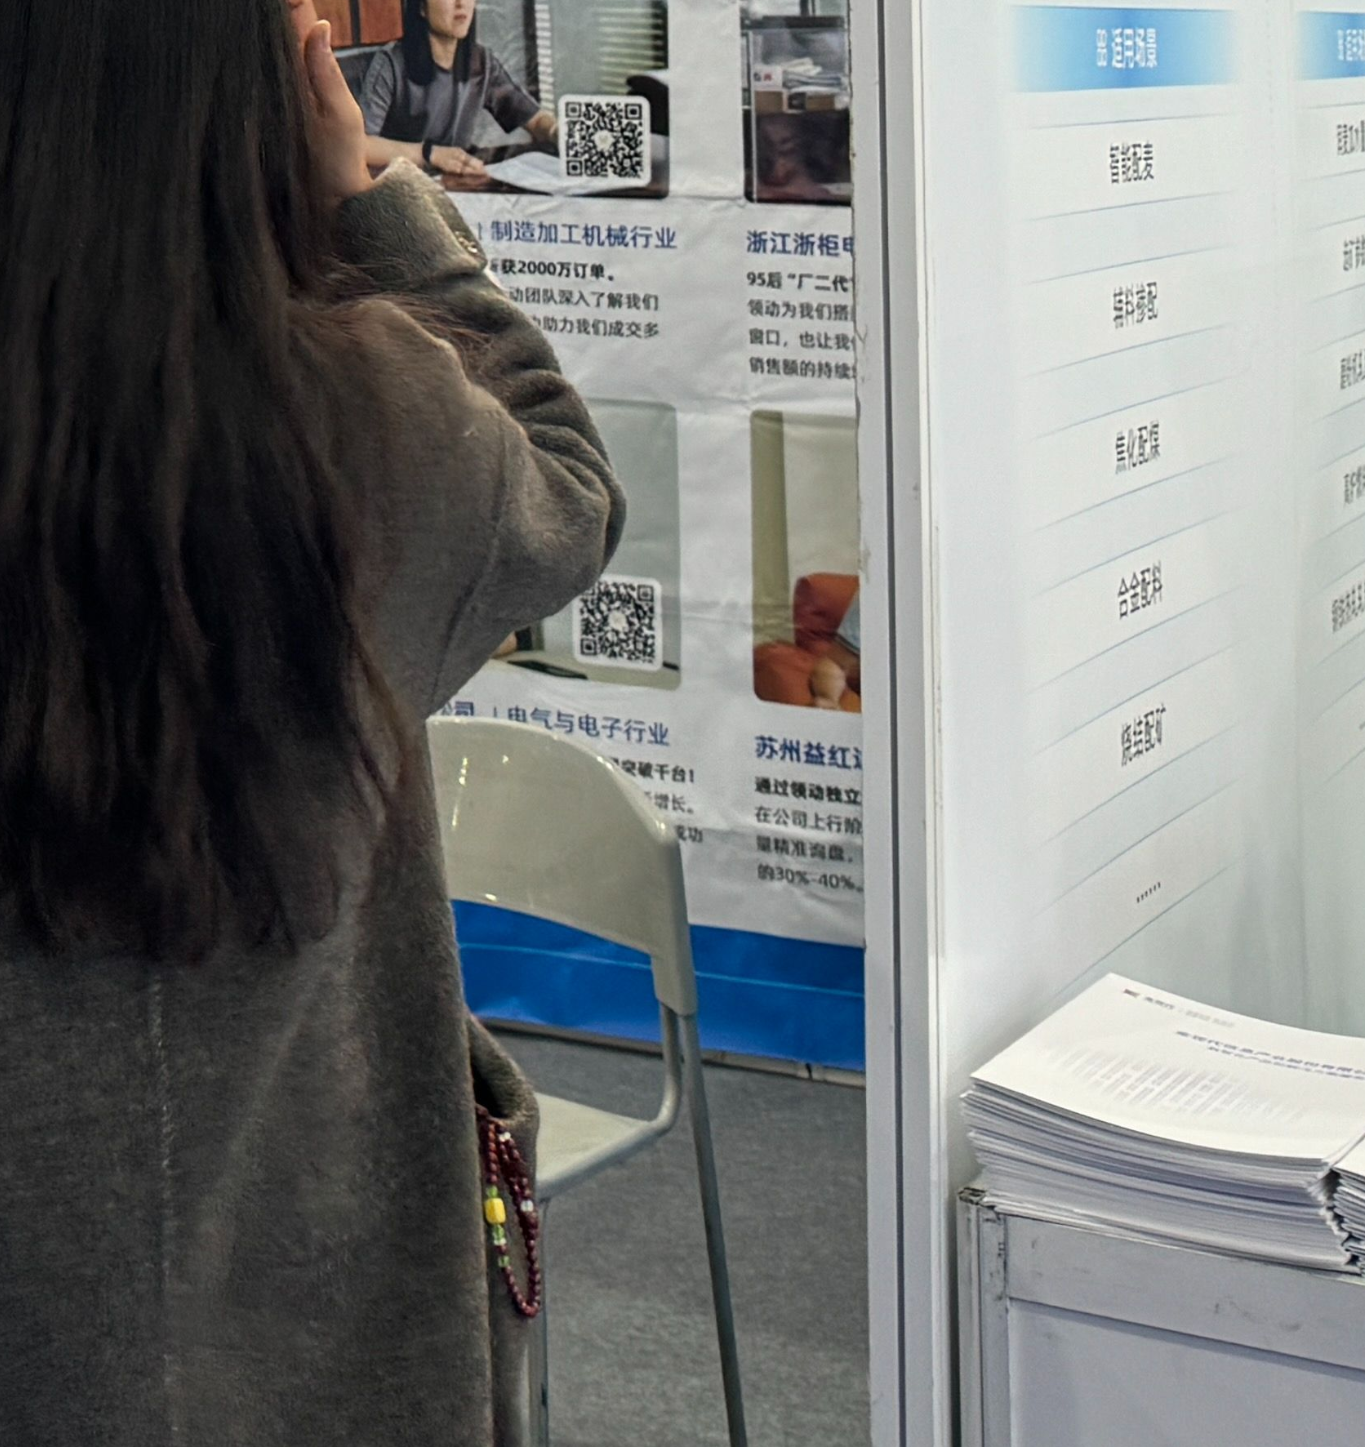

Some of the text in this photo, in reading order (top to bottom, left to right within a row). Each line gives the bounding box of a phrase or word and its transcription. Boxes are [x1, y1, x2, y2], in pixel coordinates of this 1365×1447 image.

[490, 219, 678, 250] 制造加工机械行业
[749, 356, 856, 380] 销售额的持续
[1117, 559, 1163, 621] 合金配料
[507, 704, 671, 747] 电气与电子行业
[642, 790, 695, 815] 增长。
